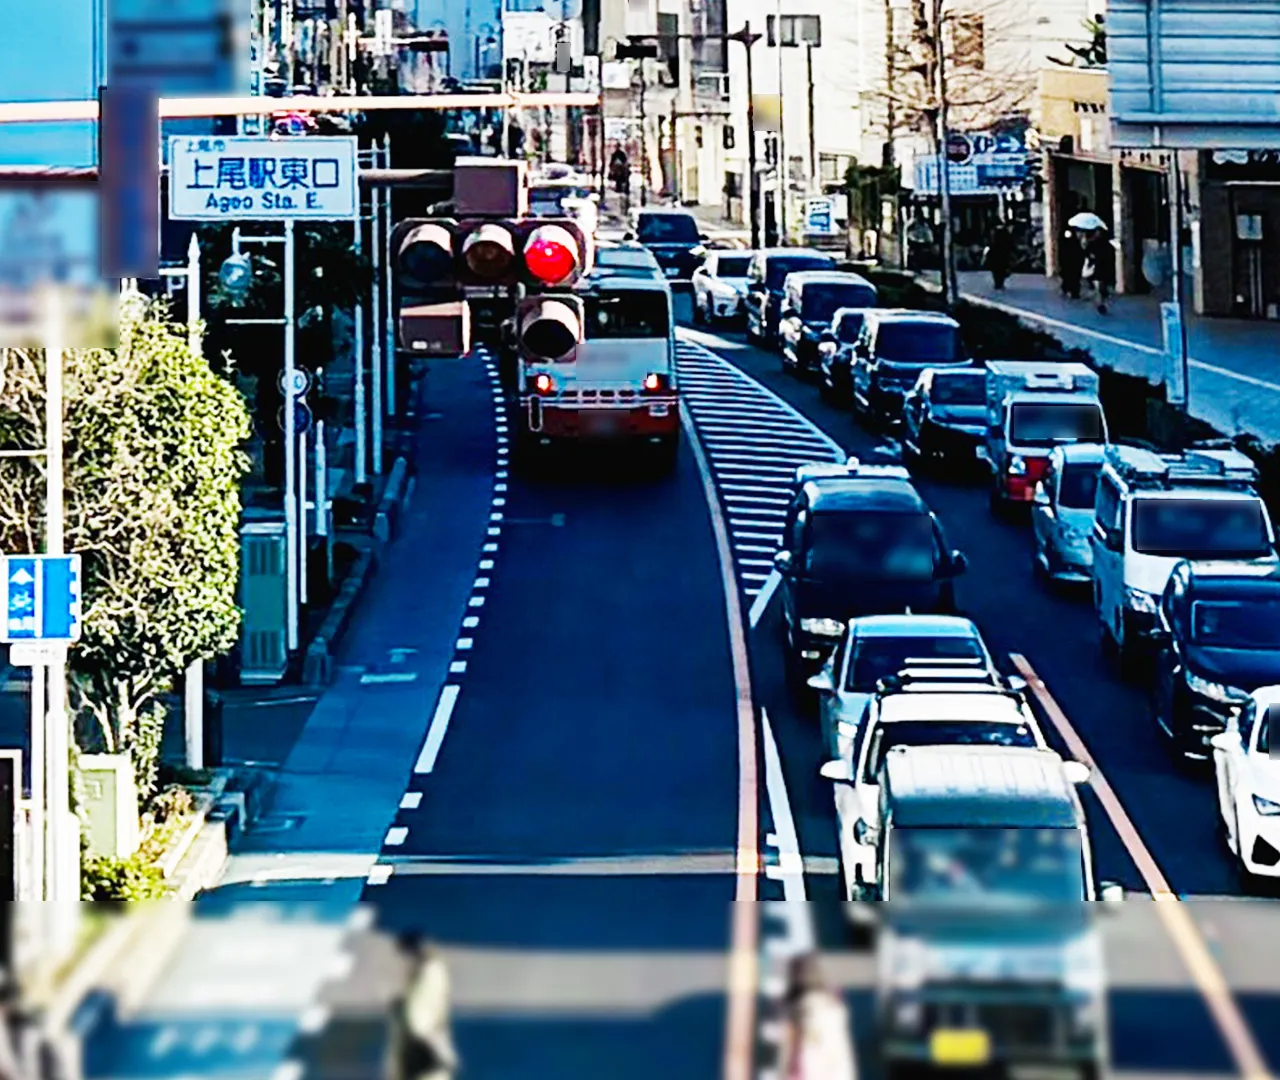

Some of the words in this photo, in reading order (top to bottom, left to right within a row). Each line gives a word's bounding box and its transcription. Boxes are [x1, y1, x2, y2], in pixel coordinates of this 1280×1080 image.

[186, 157, 339, 190] 上尾駅東口
